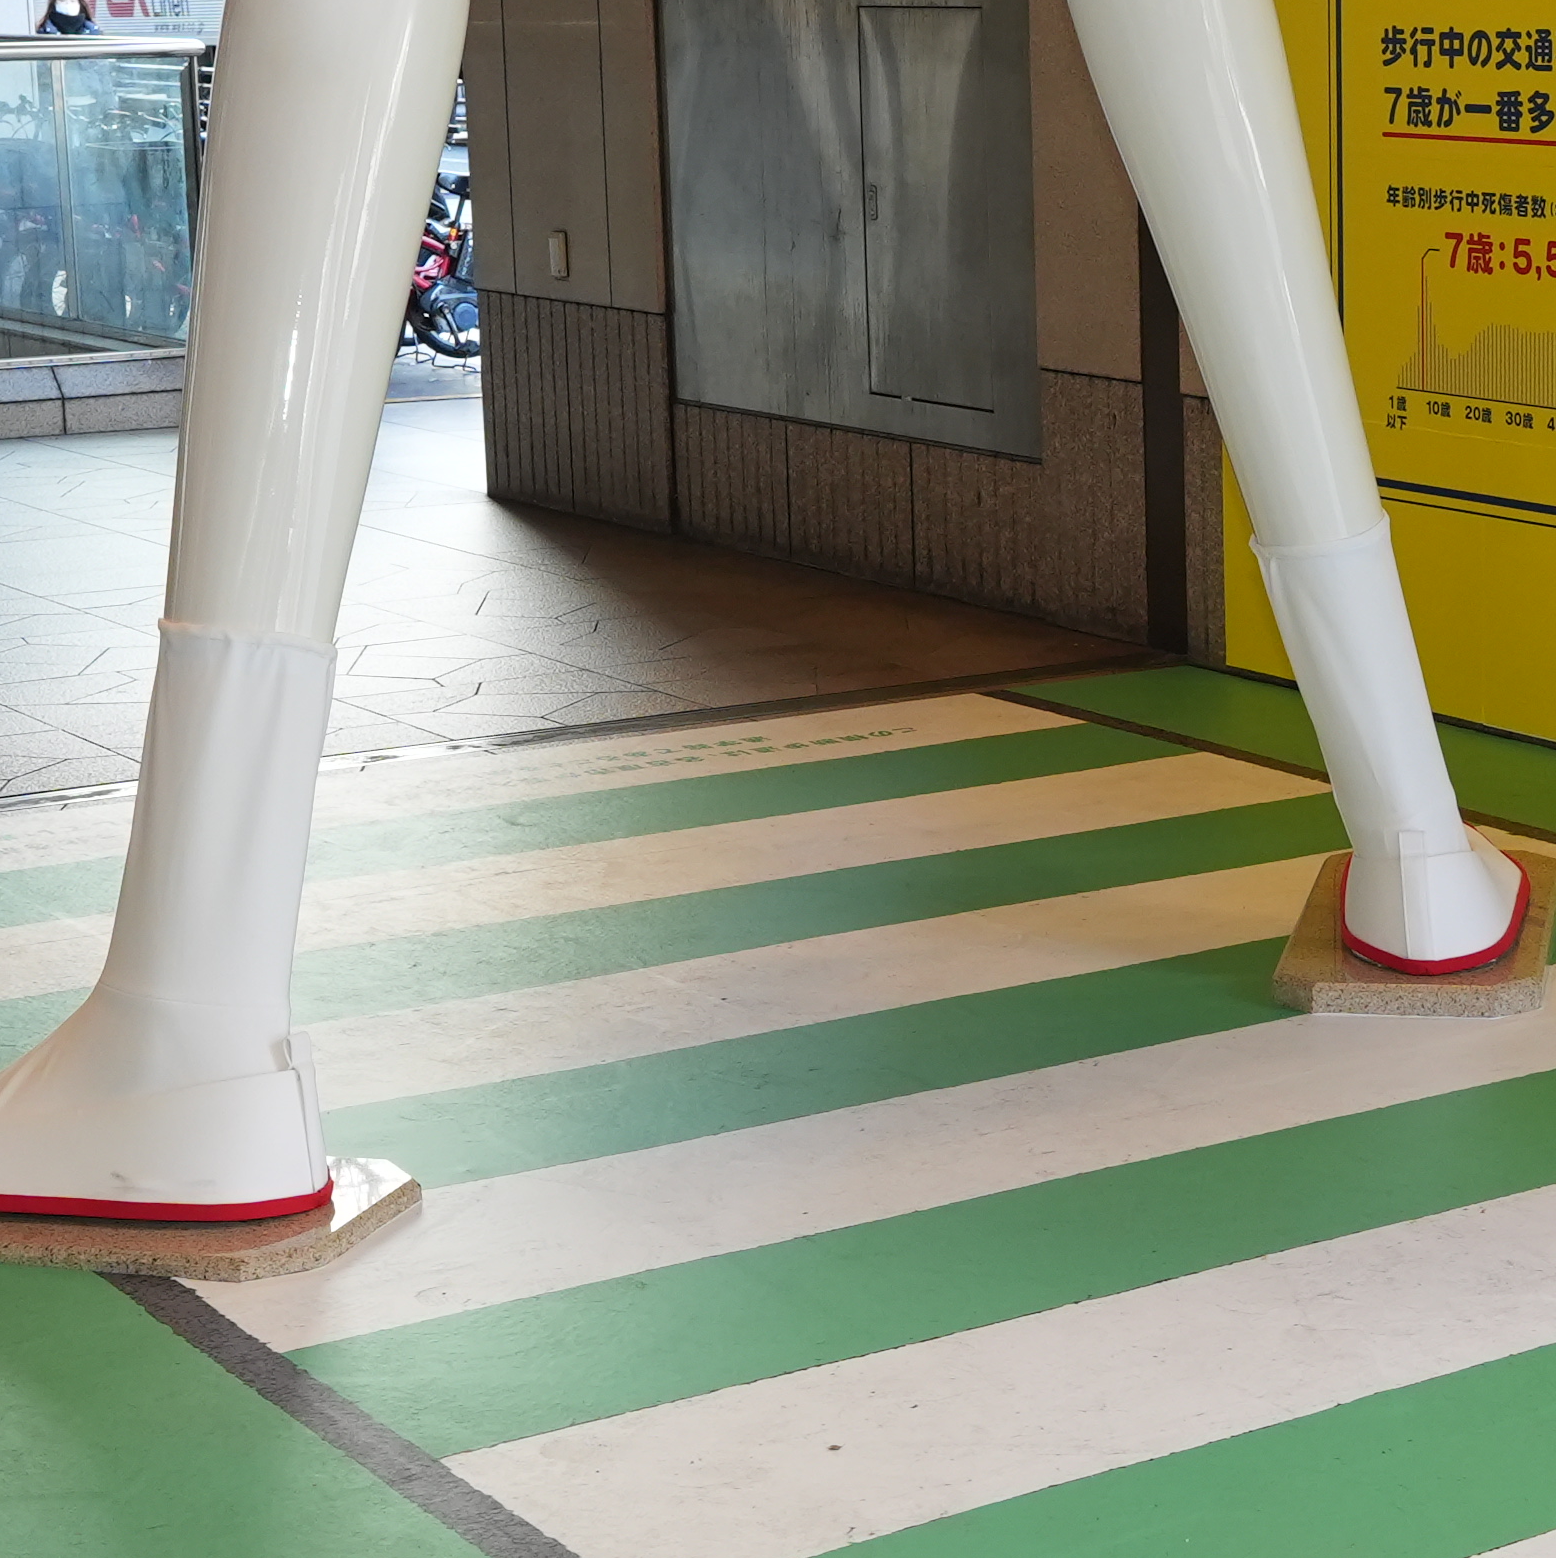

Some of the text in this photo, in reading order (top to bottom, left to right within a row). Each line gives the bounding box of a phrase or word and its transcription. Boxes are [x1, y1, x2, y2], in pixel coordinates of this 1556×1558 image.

[1386, 184, 1546, 219] 年齢別歩行中死傷者数
[1386, 414, 1407, 432] 以下
[1388, 395, 1407, 412] 1歳
[1426, 400, 1451, 418] 10歳
[1464, 405, 1492, 424] 20歳
[1505, 411, 1534, 430] 30歳
